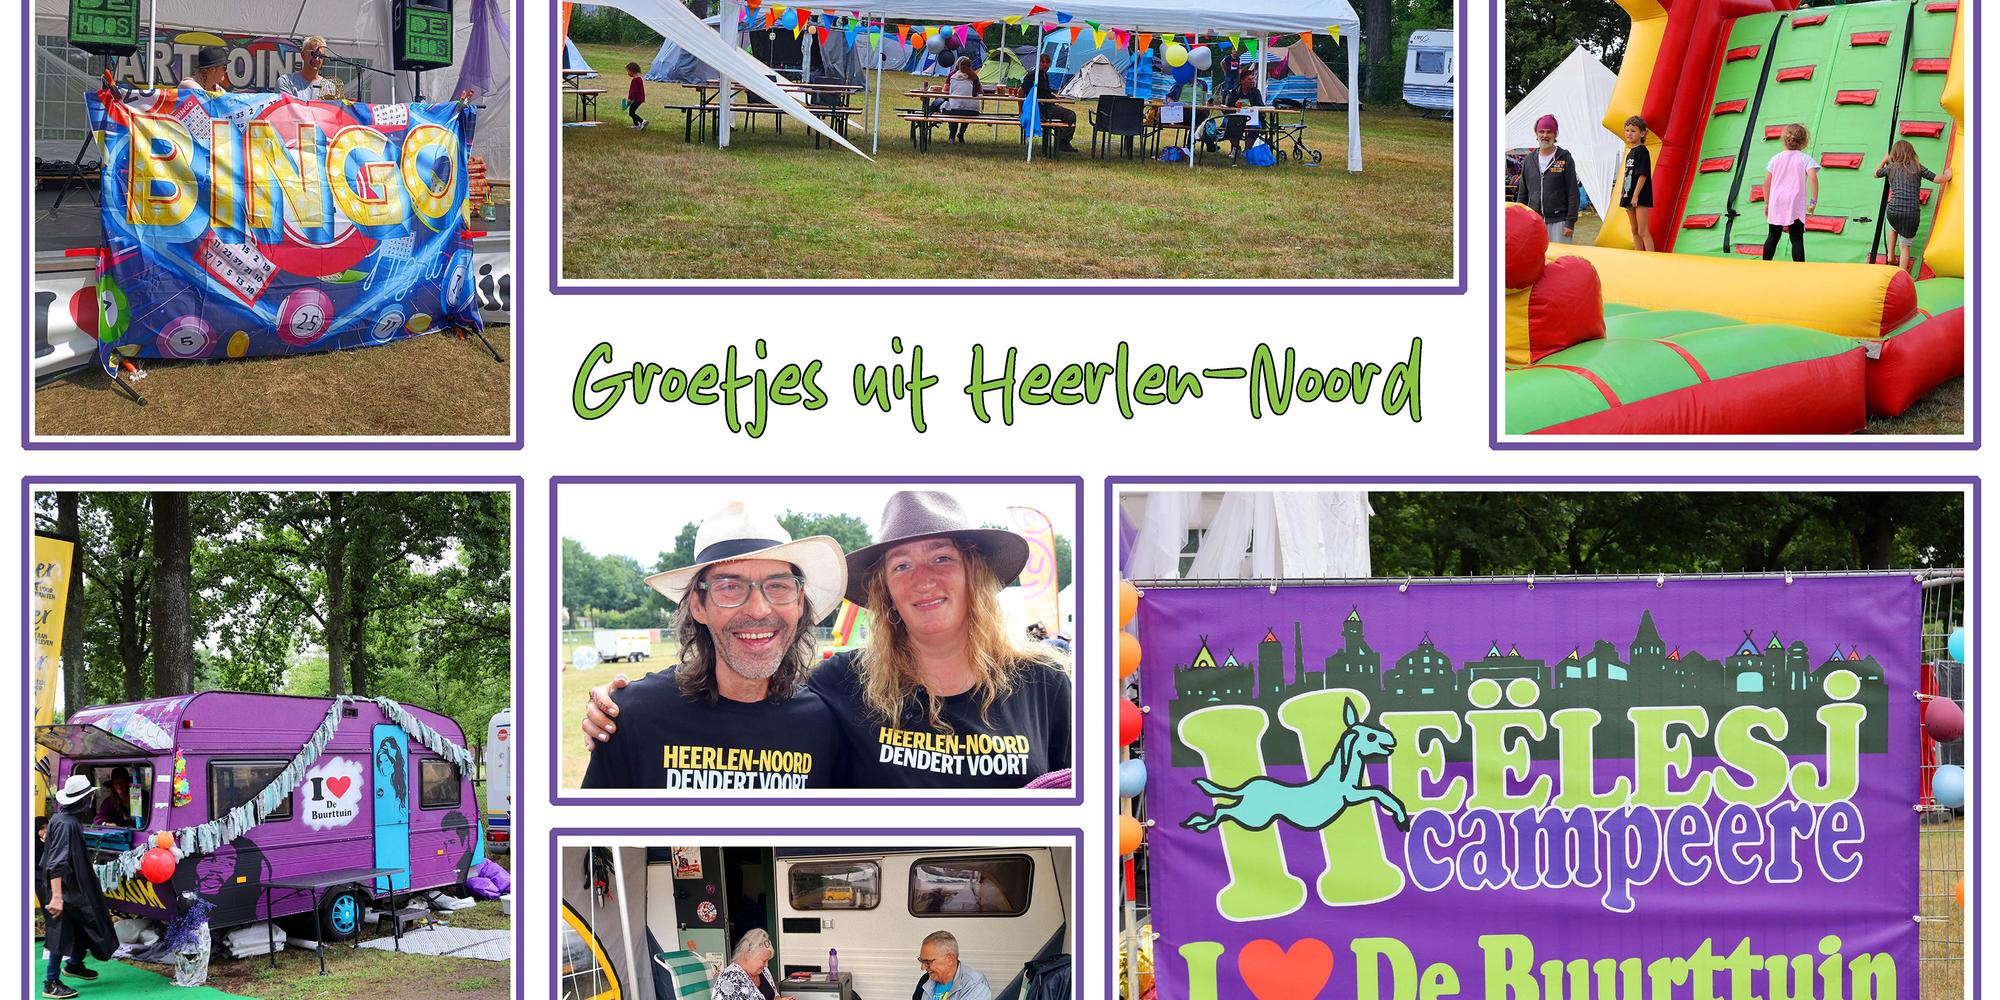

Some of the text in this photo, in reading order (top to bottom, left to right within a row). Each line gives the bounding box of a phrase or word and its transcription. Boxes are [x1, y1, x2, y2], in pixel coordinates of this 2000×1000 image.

[79, 14, 130, 35] HOOS
[410, 15, 448, 35] DE
[410, 36, 448, 57] HOOS
[126, 113, 460, 229] BINGO
[222, 246, 233, 259] 22
[232, 255, 244, 267] 37
[253, 254, 260, 263] 2
[262, 261, 272, 272] 19
[226, 268, 233, 277] 5
[235, 275, 244, 287] 13
[245, 284, 256, 295] 18
[296, 312, 319, 331] 25
[180, 335, 194, 347] 5
[879, 726, 1031, 756] HEERLEN-NOORD
[663, 745, 813, 775] HEERLEN-NOORD
[879, 744, 1029, 777] DENDERT VOORT
[310, 777, 325, 802] I
[311, 808, 352, 820] Buurttuin
[326, 800, 337, 809] De
[1404, 799, 1866, 914] campeere
[1178, 933, 1897, 1000] I De Buurttuin
